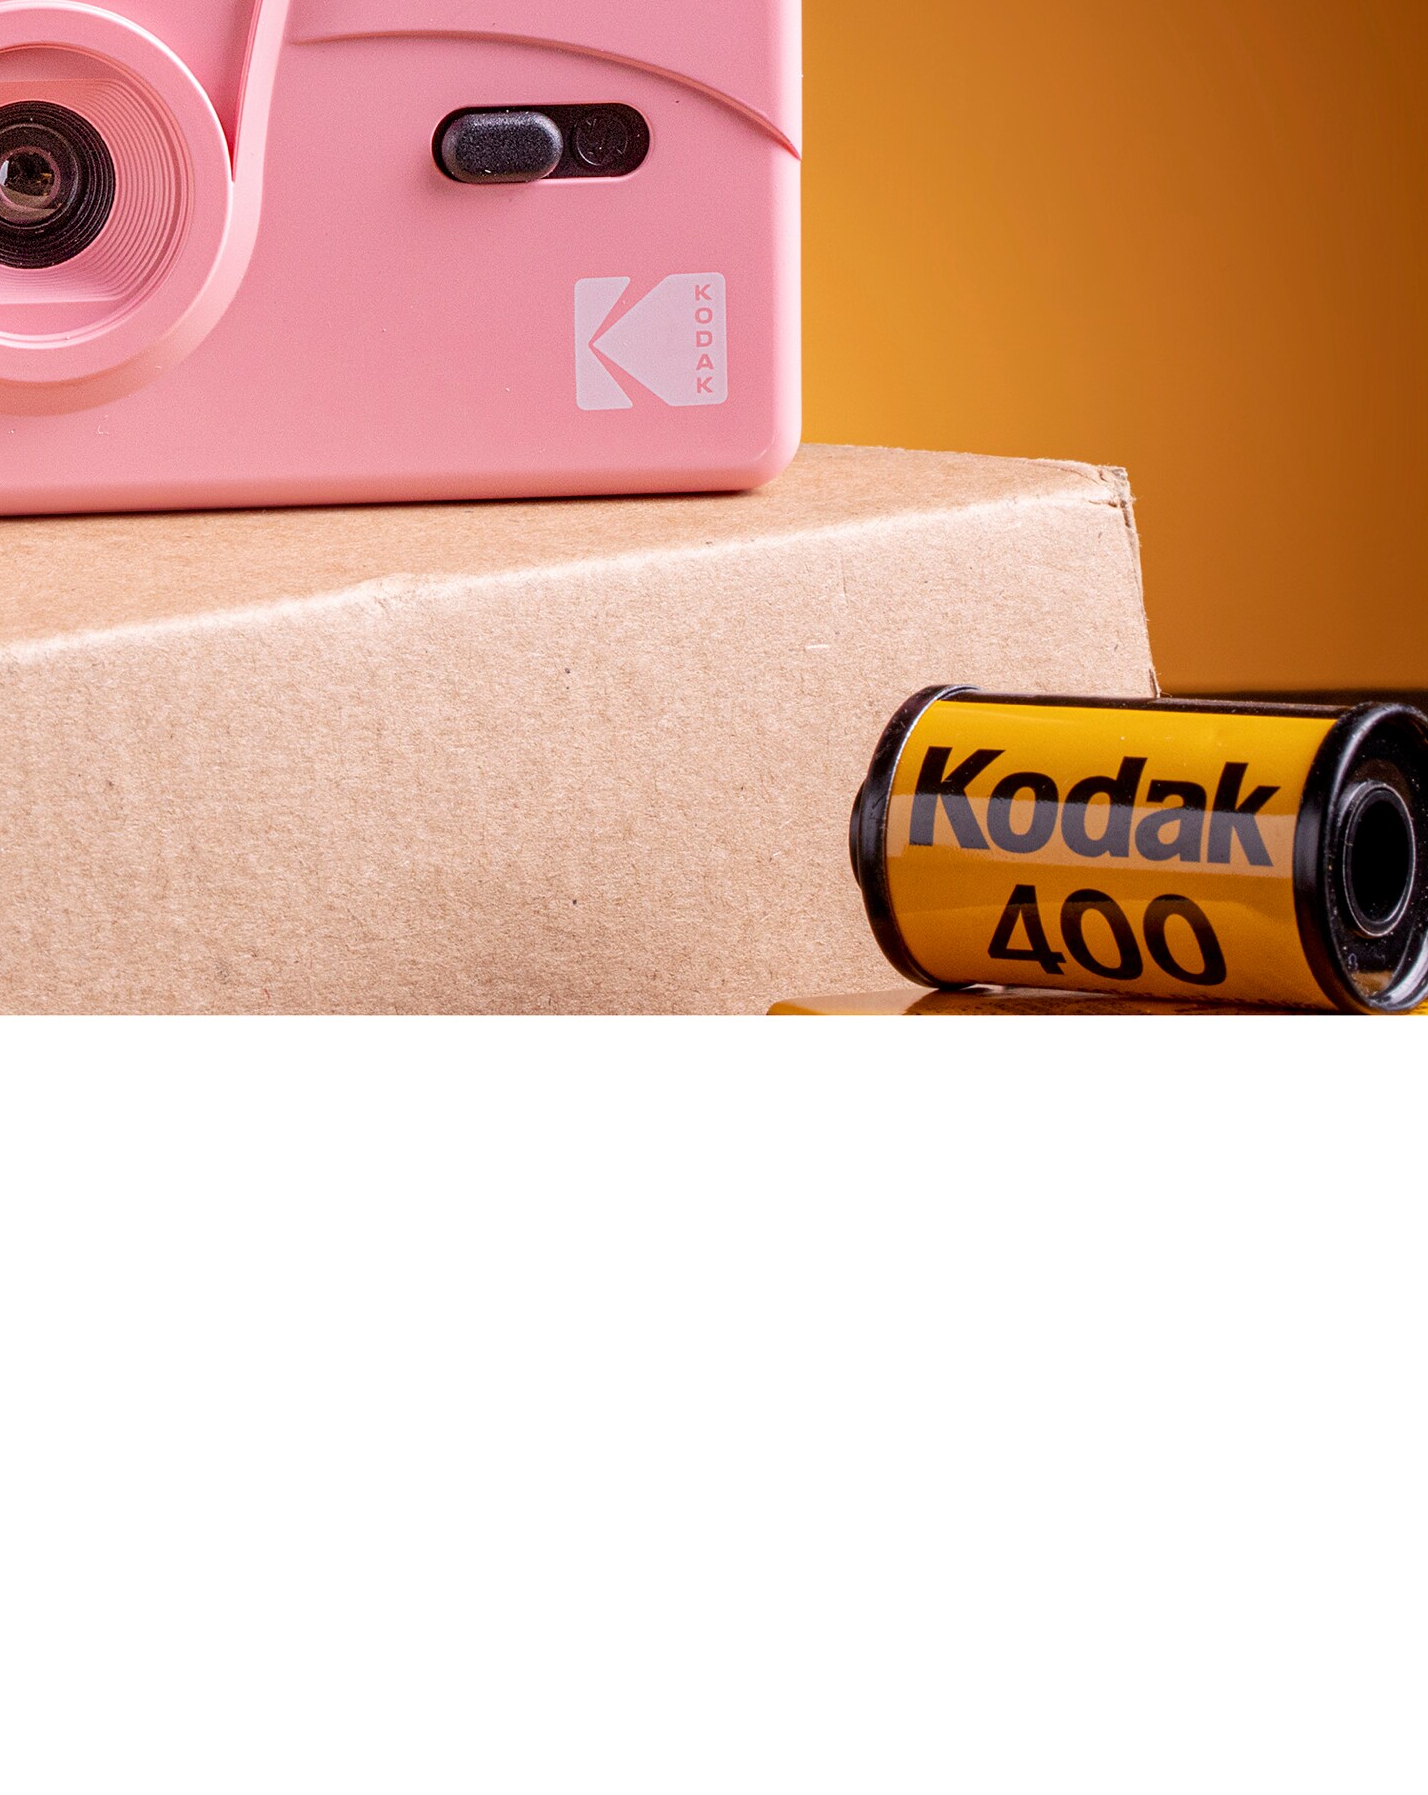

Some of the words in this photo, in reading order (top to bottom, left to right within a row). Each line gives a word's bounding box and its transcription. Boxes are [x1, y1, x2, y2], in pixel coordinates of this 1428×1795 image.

[694, 284, 714, 393] KODAK
[909, 745, 1280, 867] Kodak
[987, 884, 1226, 985] 400
